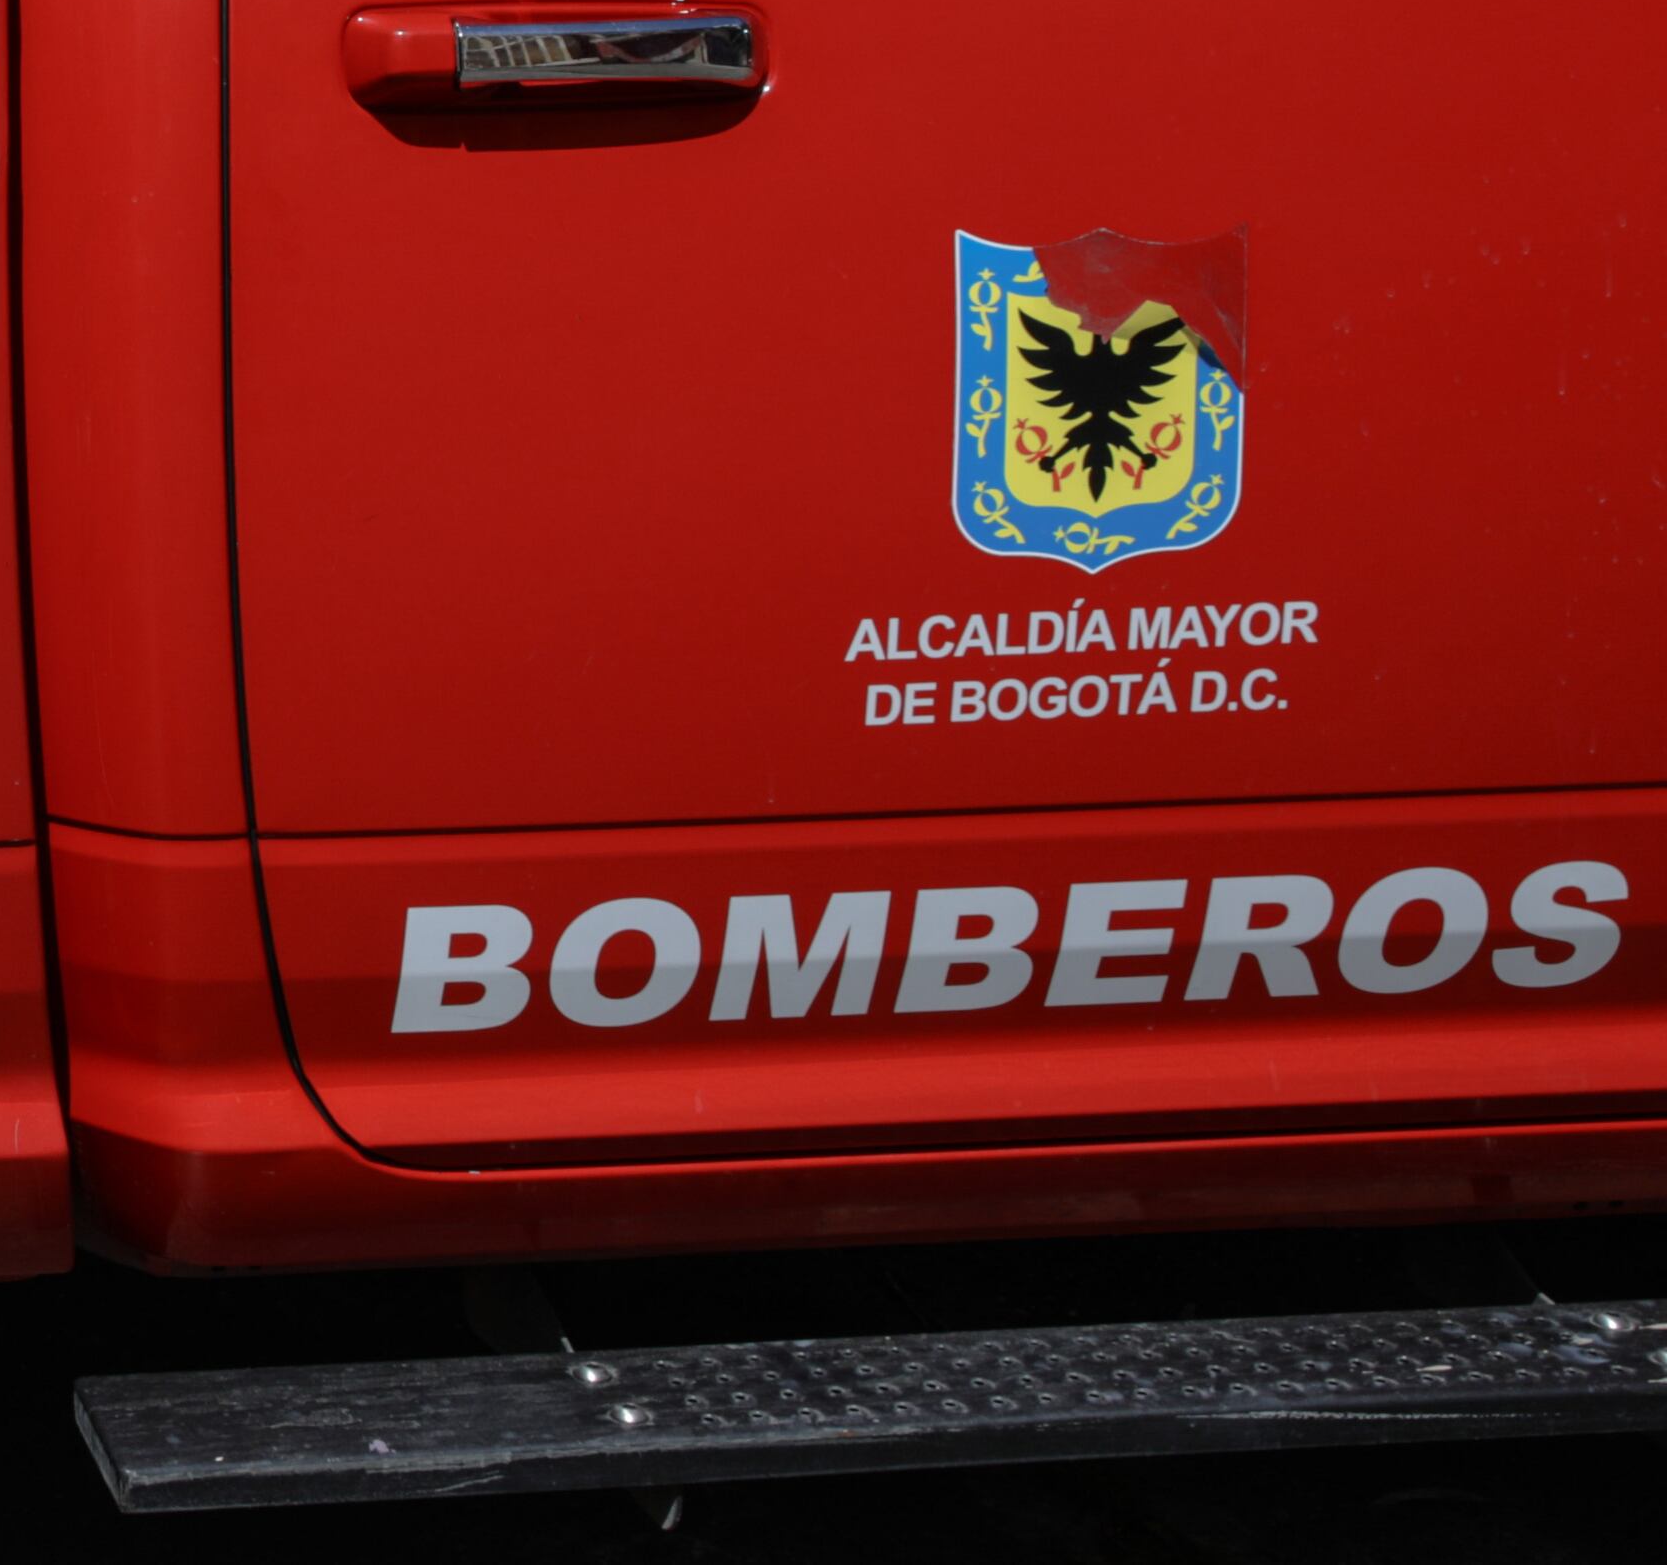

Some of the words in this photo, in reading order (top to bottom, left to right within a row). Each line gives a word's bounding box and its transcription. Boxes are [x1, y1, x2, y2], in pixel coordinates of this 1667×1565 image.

[844, 598, 1116, 662] ALCALDÍA
[1127, 600, 1319, 652] MAYOR
[865, 682, 937, 727] DE
[950, 657, 1177, 723] BOGOTÁ
[1191, 668, 1288, 713] D.C.
[391, 860, 1630, 1034] BOMBEROS
